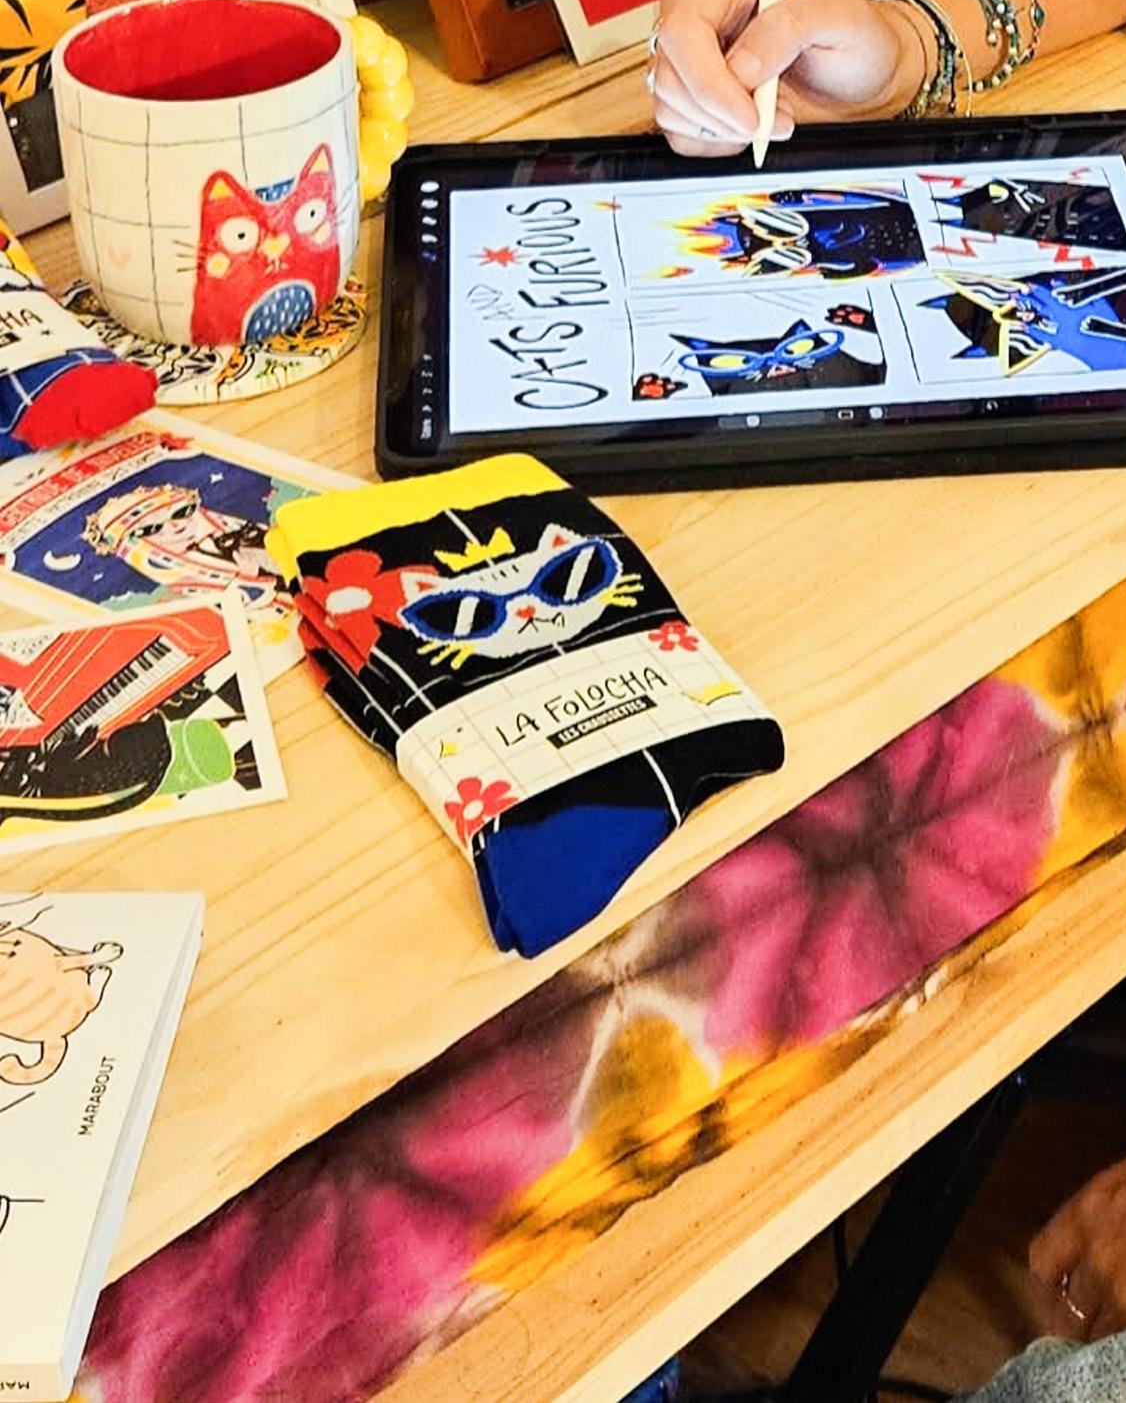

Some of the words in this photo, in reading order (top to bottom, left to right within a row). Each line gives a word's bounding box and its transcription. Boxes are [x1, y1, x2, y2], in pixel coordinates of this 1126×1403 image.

[506, 198, 611, 309] FURIOUS
[467, 283, 528, 321] AND
[488, 322, 609, 411] CATS
[495, 711, 541, 747] LA
[77, 1055, 116, 1136] MARABOUT
